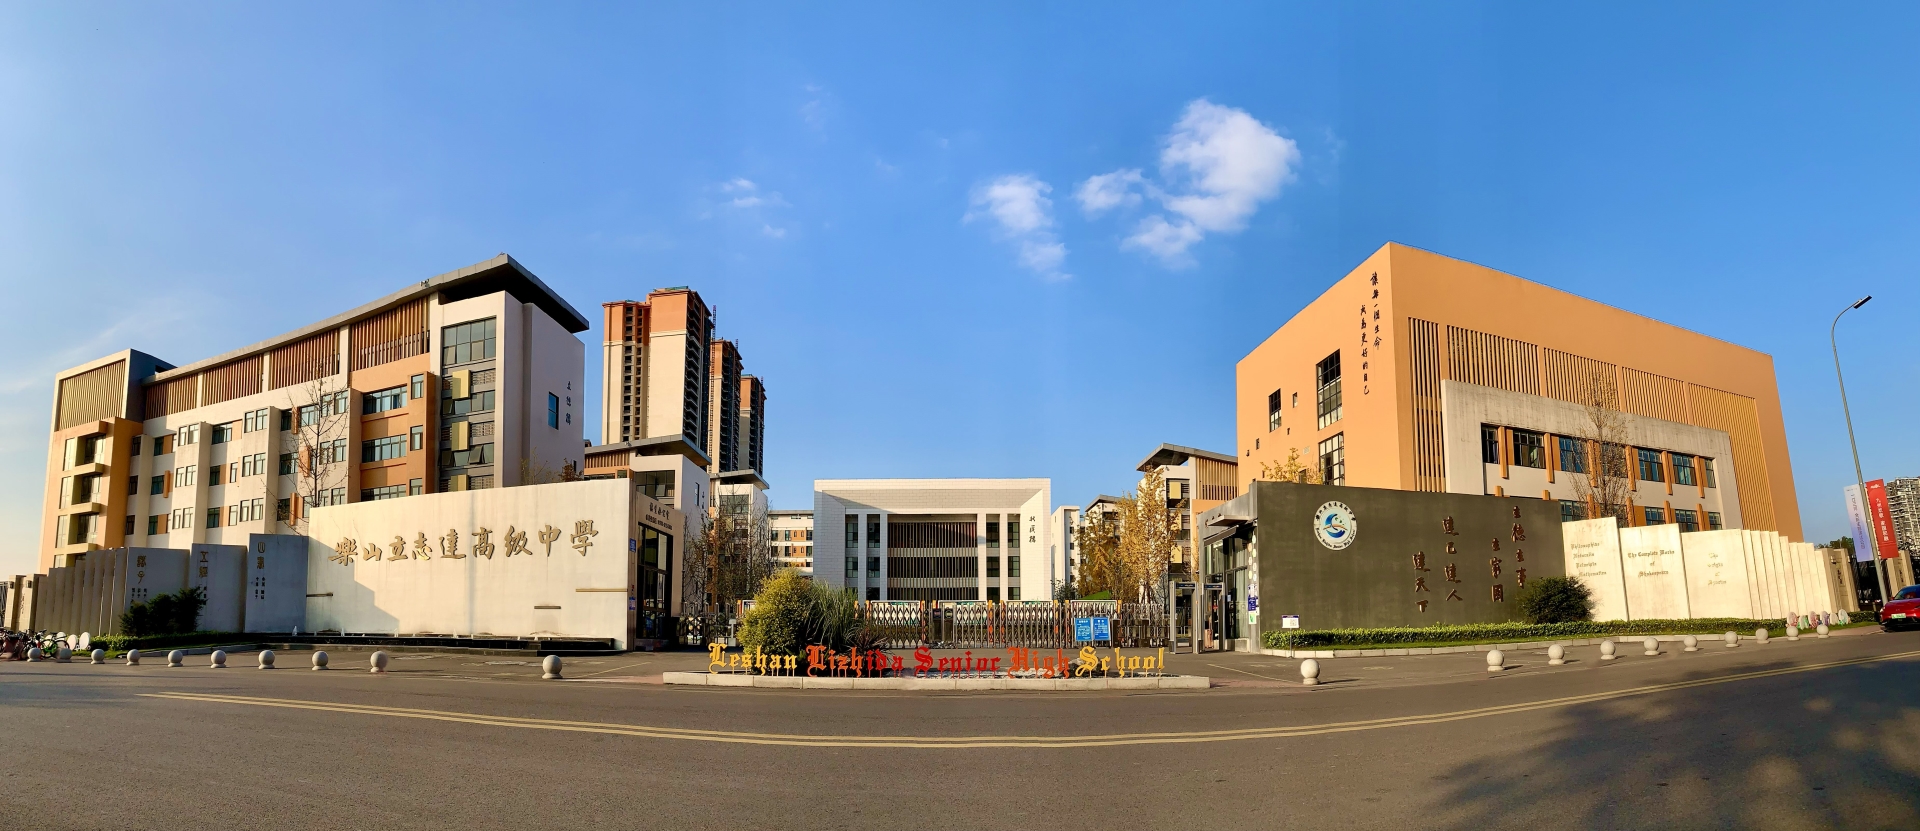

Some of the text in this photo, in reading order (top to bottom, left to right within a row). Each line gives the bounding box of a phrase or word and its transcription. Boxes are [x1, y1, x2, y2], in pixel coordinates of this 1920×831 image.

[328, 519, 599, 567] 樂山立志達高級中學
[708, 642, 1165, 679] Leshan Lizhida Senior High School
